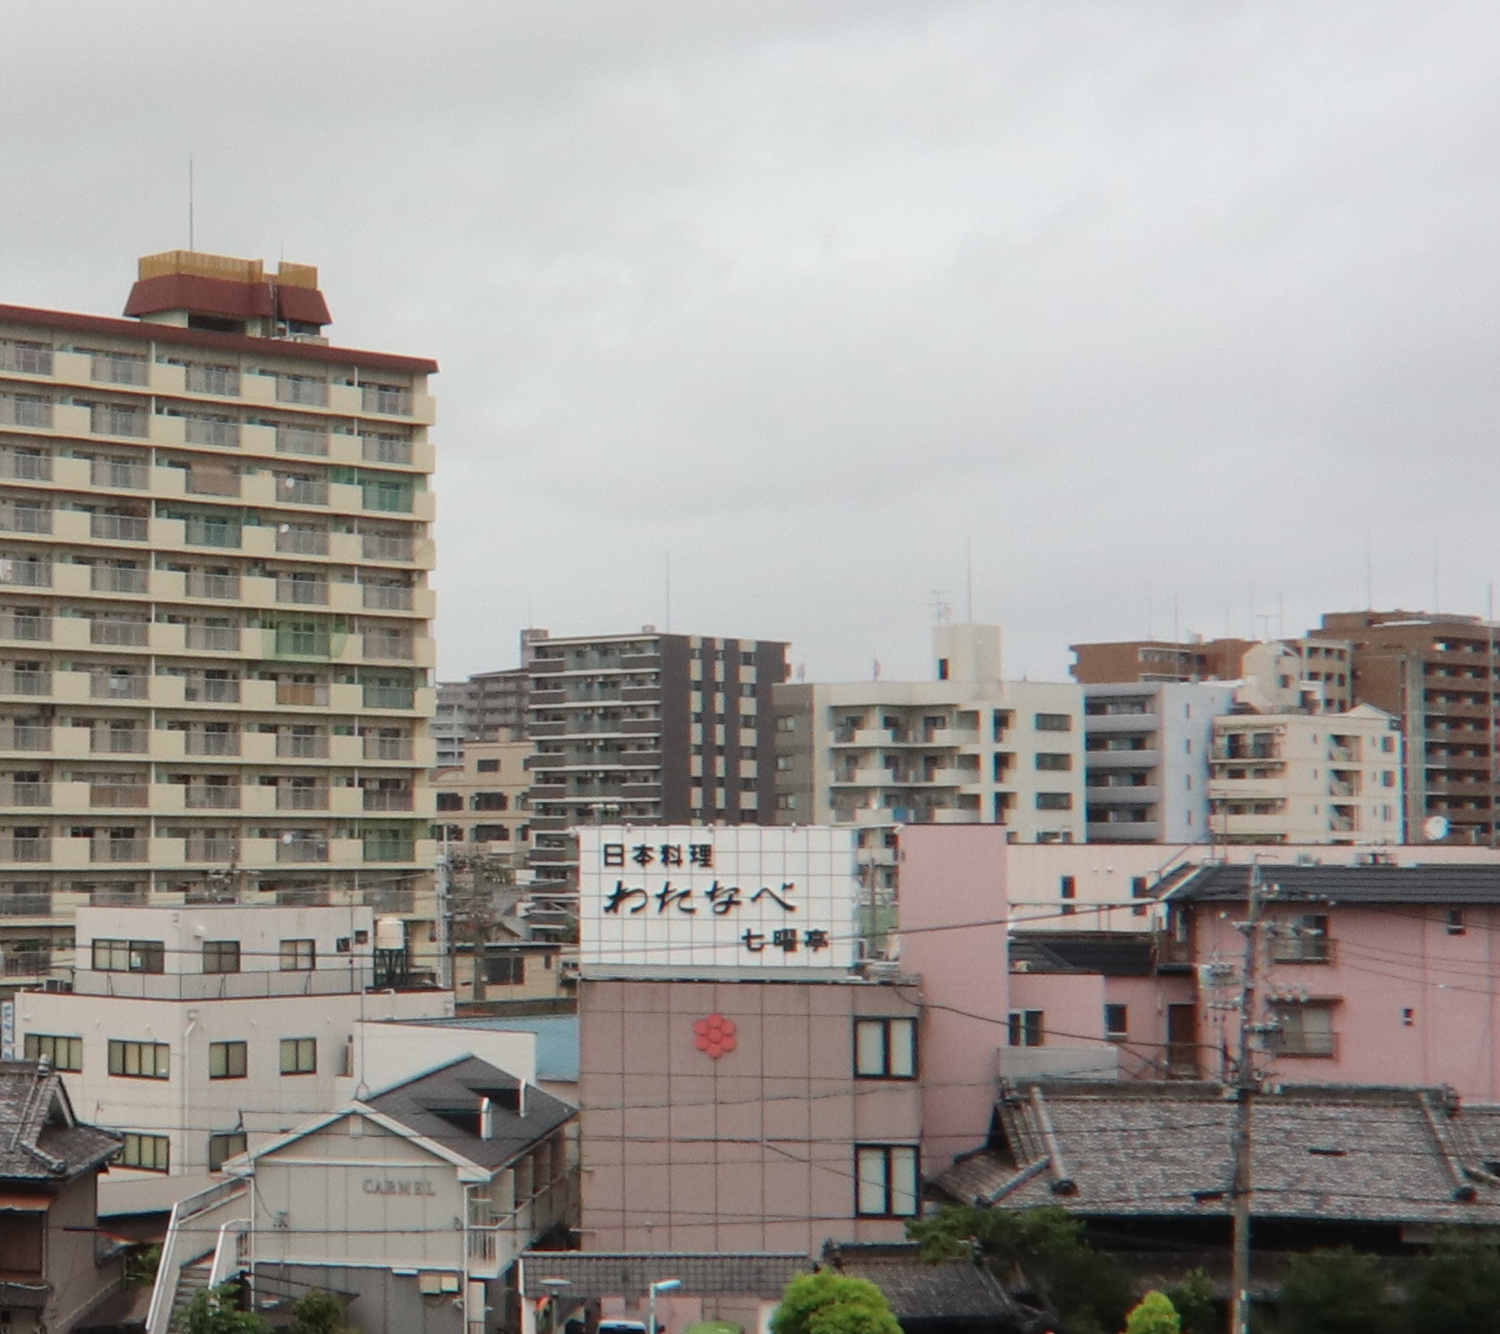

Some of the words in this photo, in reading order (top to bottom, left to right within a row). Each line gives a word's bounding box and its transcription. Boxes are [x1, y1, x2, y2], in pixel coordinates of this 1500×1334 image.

[603, 843, 713, 868] 日本料理
[603, 879, 798, 915] わたなべ
[741, 928, 830, 953] 七曜亭
[362, 1178, 437, 1196] CARMEL
